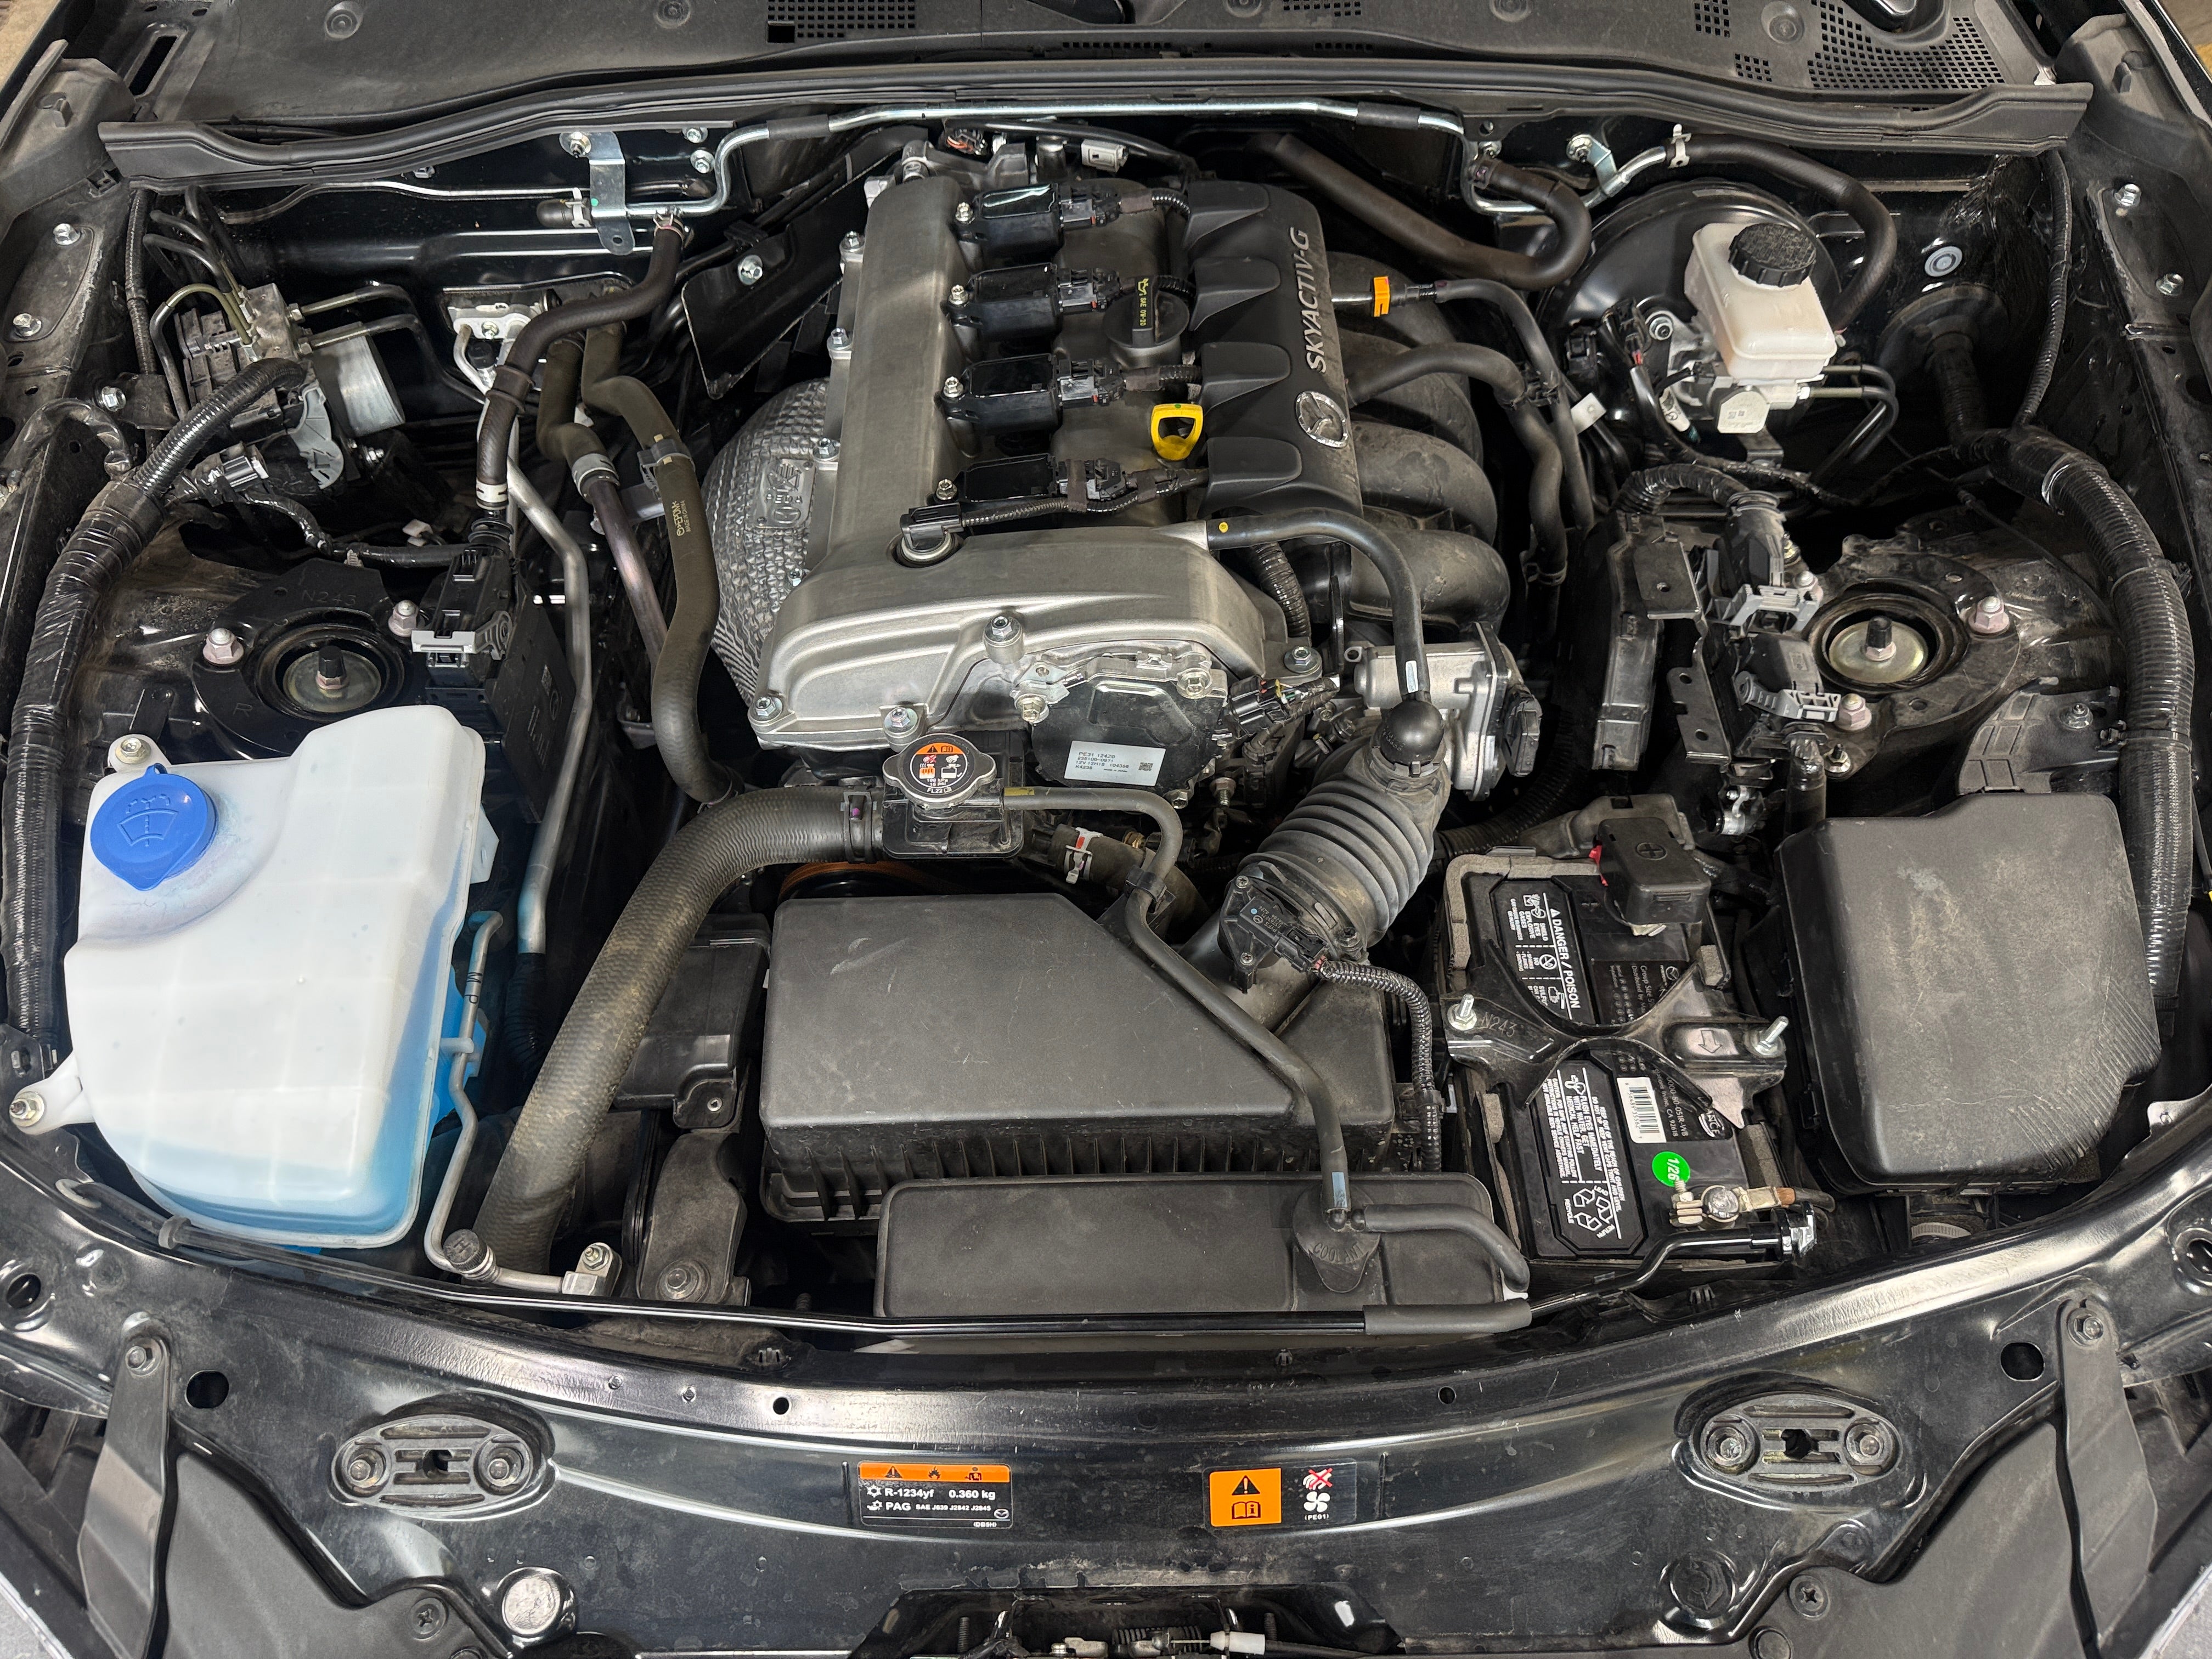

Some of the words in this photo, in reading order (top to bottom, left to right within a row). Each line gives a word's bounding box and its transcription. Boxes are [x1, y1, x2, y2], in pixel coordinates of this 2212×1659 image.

[1289, 227, 1327, 374] SKYACTIV-G
[1139, 309, 1147, 326] 0W-20
[683, 519, 691, 532] MADE
[1263, 920, 1278, 933] PYFS
[1517, 911, 1527, 928] GASES
[1524, 911, 1536, 938] EXPLOSIVE
[1532, 922, 1541, 936] EYES
[1538, 923, 1549, 940] SHIELD
[1551, 918, 1570, 958] DANGER
[1562, 970, 1581, 1008] POISON
[1630, 965, 1643, 992] Distributed
[1639, 965, 1650, 984] Group
[1644, 985, 1654, 997] Size
[1480, 1011, 1518, 1038] N243
[1542, 1093, 1553, 1115] AVAILABLE
[1555, 1099, 1564, 1108] FOR
[1565, 1096, 1577, 1120] MEDICAL
[1578, 1095, 1590, 1115] FLUSH
[1593, 1104, 1601, 1114] NOT
[1545, 1079, 1558, 1109] INSTRUCTIONS
[1553, 1117, 1563, 1135] VEHICLE
[1558, 1136, 1567, 1156] OWNERS
[1557, 1109, 1566, 1120] SAFE
[1599, 1106, 1607, 1119] KEEP
[1666, 1108, 1674, 1118] CA
[1547, 1116, 1556, 1128] SEEK
[1560, 1122, 1568, 1134] JUMP
[1572, 1096, 1582, 1110] WITH
[1580, 1135, 1590, 1147] GET
[1583, 1115, 1594, 1130] EYES
[1601, 1120, 1610, 1130] OUT
[1668, 1119, 1679, 1137] 92618
[1570, 1122, 1581, 1137] HELP
[1598, 1126, 1606, 1139] KEEP
[1604, 1131, 1612, 1139] OF
[1550, 1129, 1560, 1148] SERVICE
[1562, 1135, 1573, 1157] STARTING
[1573, 1138, 1585, 1154] FAST
[1606, 1139, 1615, 1149] THE
[1587, 1132, 1602, 1171] IMMEDIATELY
[1600, 1141, 1609, 1153] VENT
[1604, 1154, 1612, 1167] CAPS
[1608, 1150, 1618, 1167] REACH
[1567, 1158, 1578, 1178] FOLLOW
[1667, 1157, 1680, 1180] 1/26
[1606, 1169, 1616, 1183] TIGHT
[1594, 1185, 1608, 1195] LEAD
[1610, 1184, 1618, 1195] AND
[1614, 1176, 1626, 1201] CHILDREN
[1562, 1199, 1575, 1224] RECYCLE
[1596, 1224, 1615, 1239] RETURN
[1313, 1242, 1364, 1264] COOLANT
[884, 1487, 934, 1499] R-1234yf
[948, 1488, 979, 1499] 0.360
[981, 1489, 996, 1500] kg
[885, 1501, 911, 1511] PAG
